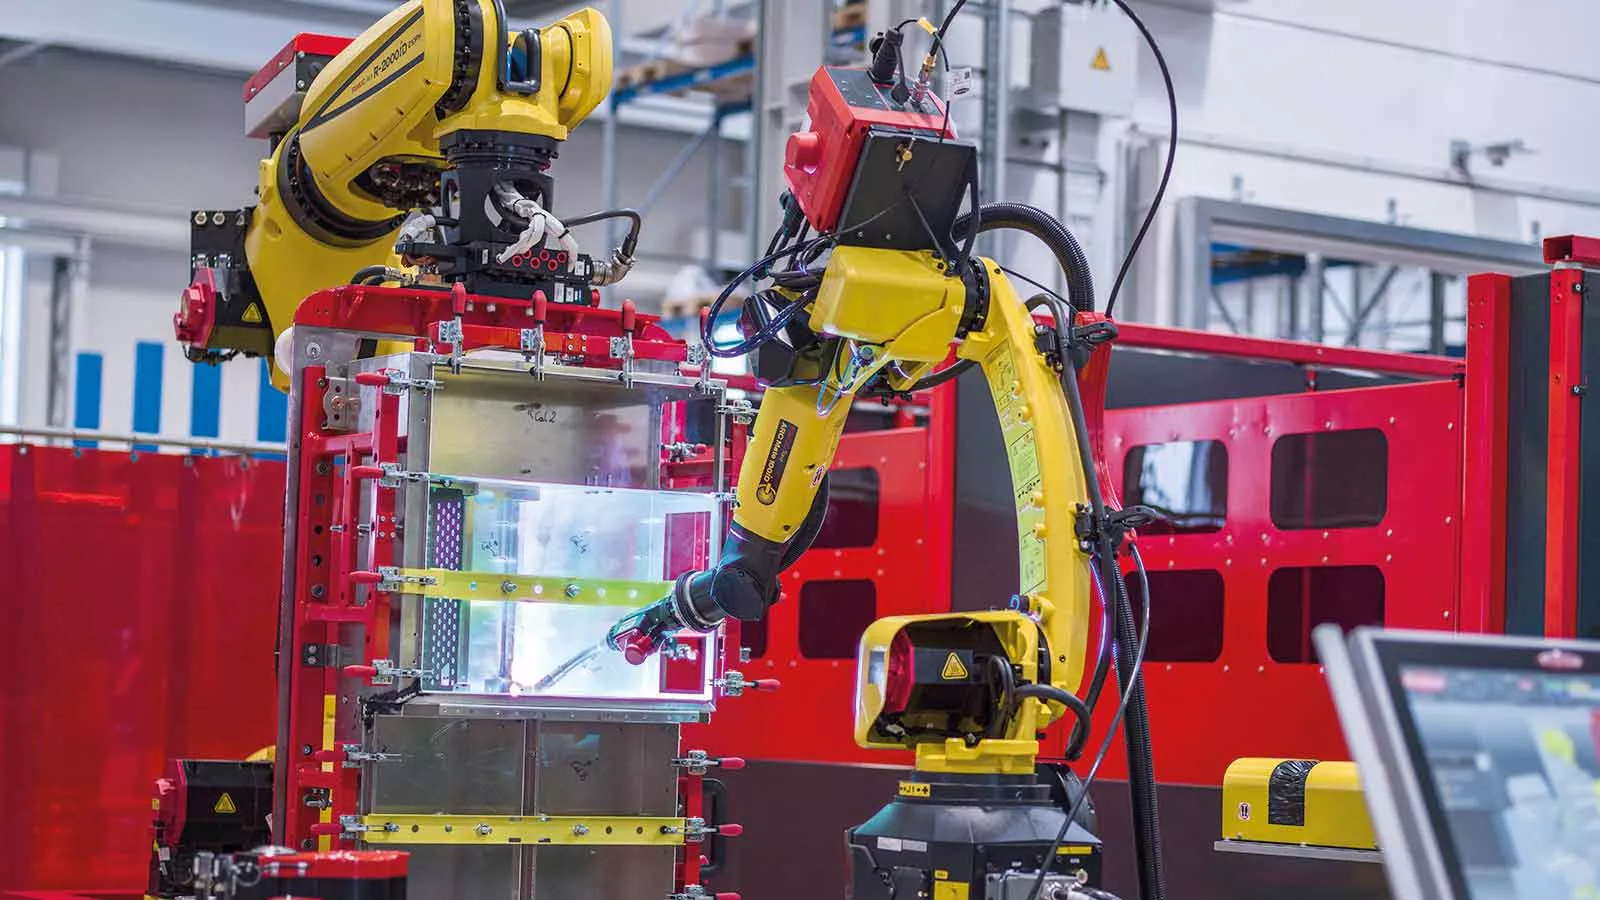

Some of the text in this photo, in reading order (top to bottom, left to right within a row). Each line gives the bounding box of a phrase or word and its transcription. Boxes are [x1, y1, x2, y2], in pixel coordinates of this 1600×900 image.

[549, 410, 558, 423] 2
[778, 421, 788, 440] ARC
[771, 439, 782, 460] Mate
